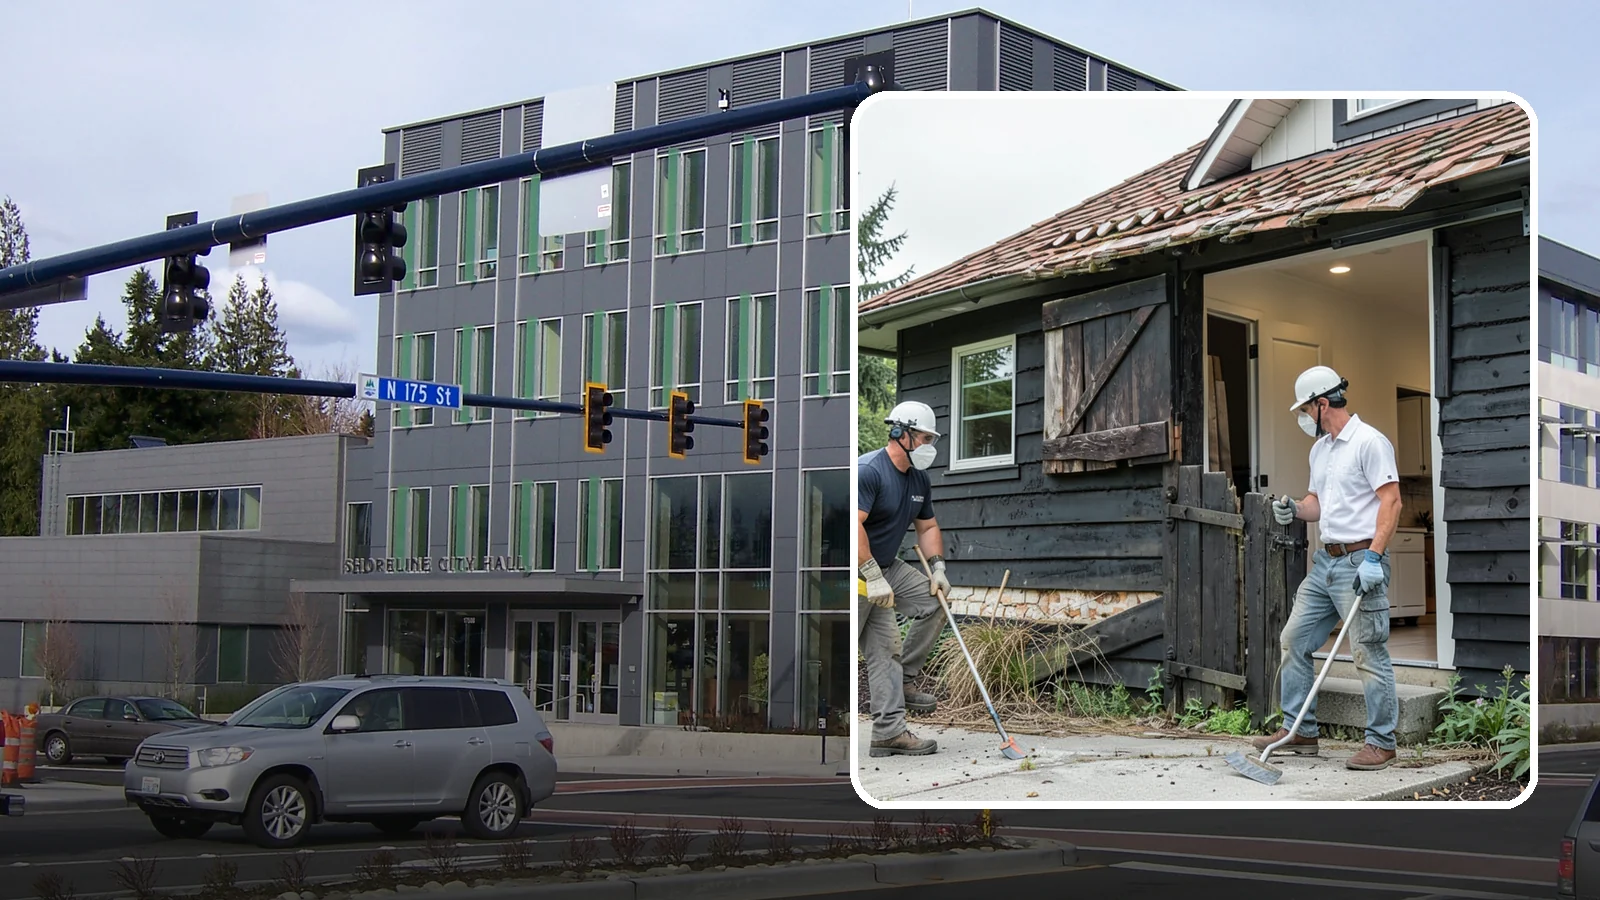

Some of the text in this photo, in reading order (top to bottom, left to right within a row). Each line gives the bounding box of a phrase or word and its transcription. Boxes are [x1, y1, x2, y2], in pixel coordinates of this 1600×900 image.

[387, 380, 451, 406] N 175 St
[344, 555, 525, 574] SHORELINE CITY HALL
